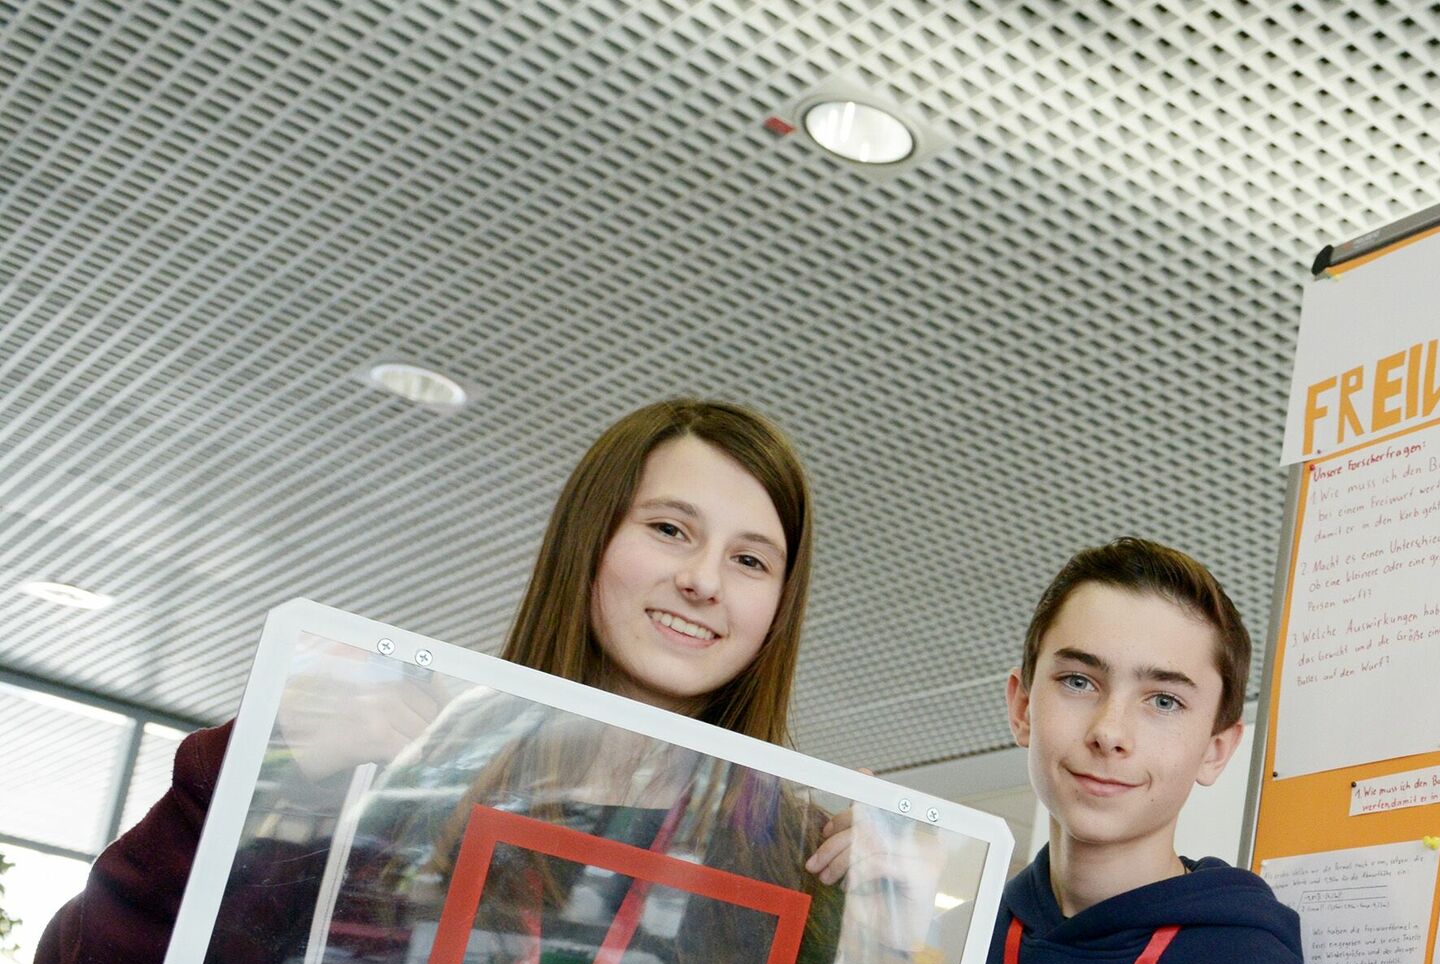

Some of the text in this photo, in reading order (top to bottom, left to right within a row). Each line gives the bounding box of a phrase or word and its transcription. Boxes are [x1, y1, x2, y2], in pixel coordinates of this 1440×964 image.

[1313, 442, 1426, 481] Unsere Forscherfragen:
[1364, 786, 1376, 797] Wie
[1414, 778, 1428, 788] den
